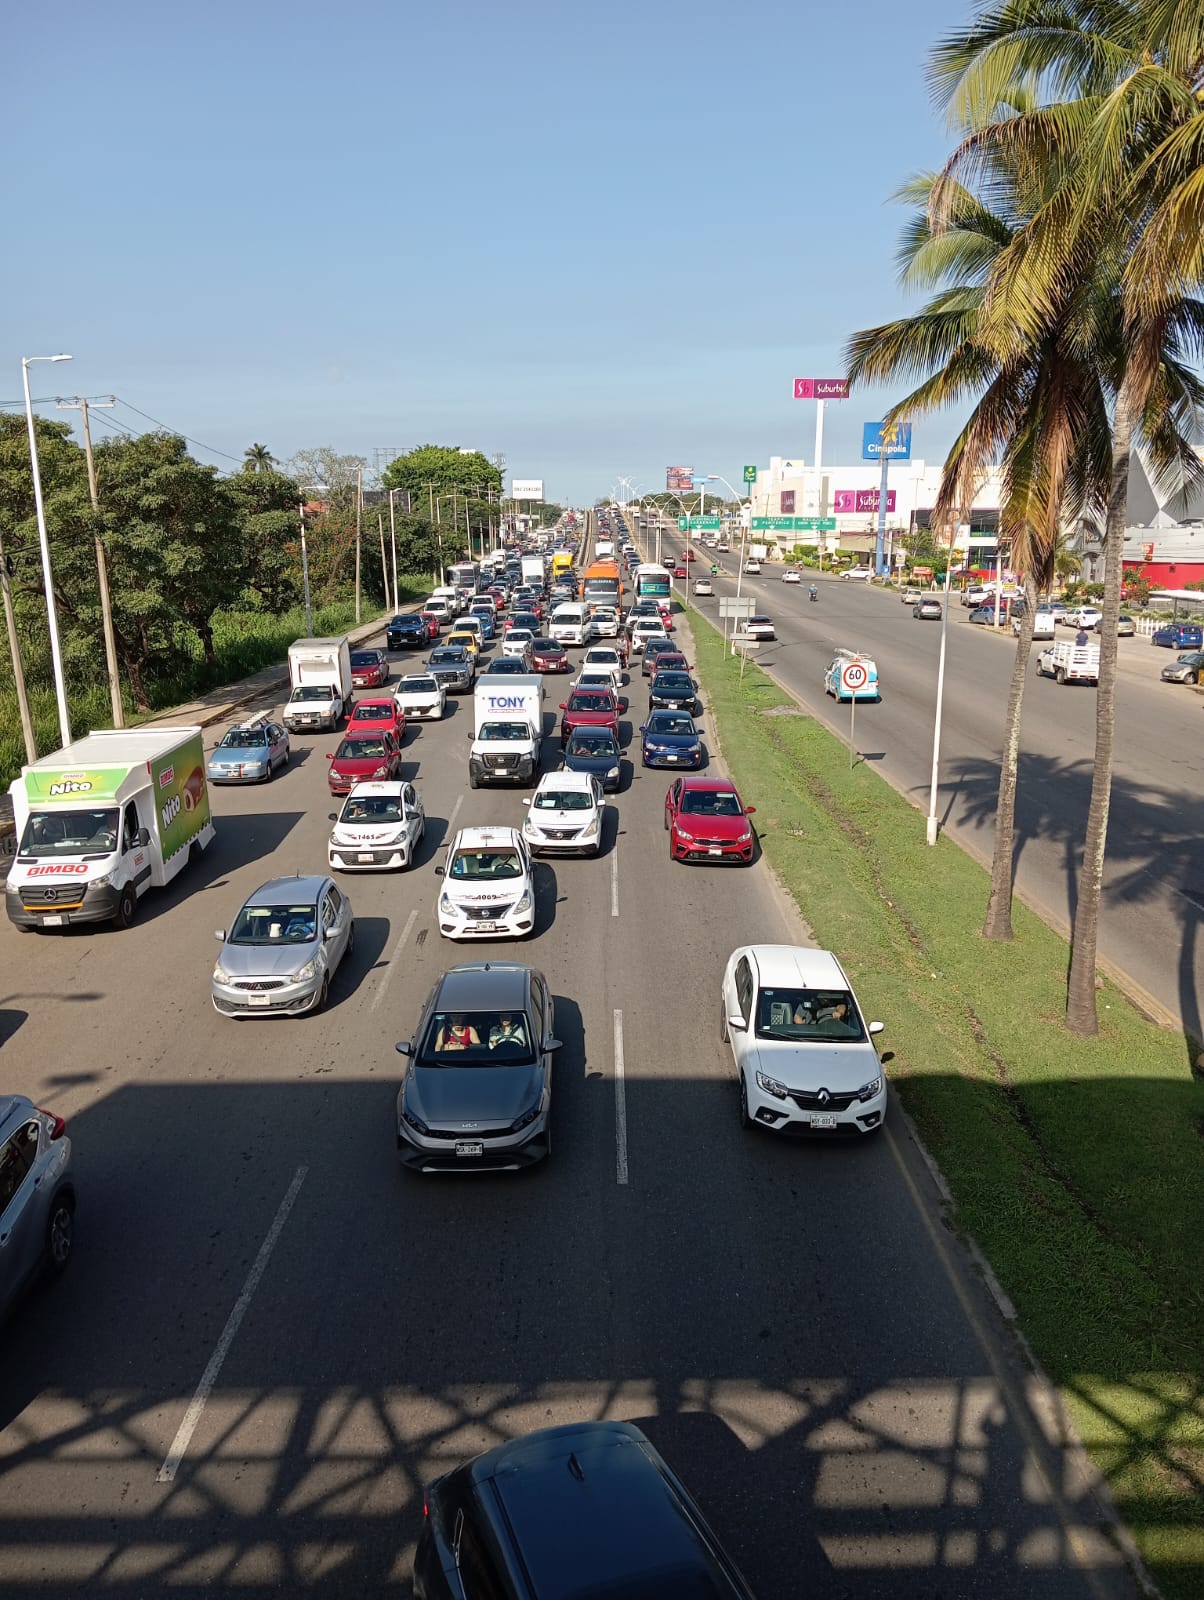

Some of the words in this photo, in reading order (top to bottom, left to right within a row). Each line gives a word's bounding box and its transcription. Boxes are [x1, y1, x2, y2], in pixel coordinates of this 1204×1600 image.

[858, 496, 893, 509] Subura
[849, 669, 861, 680] 60
[488, 697, 525, 708] TONY
[50, 781, 91, 796] Nito
[162, 794, 181, 829] Nito
[27, 864, 88, 876] BIMBO
